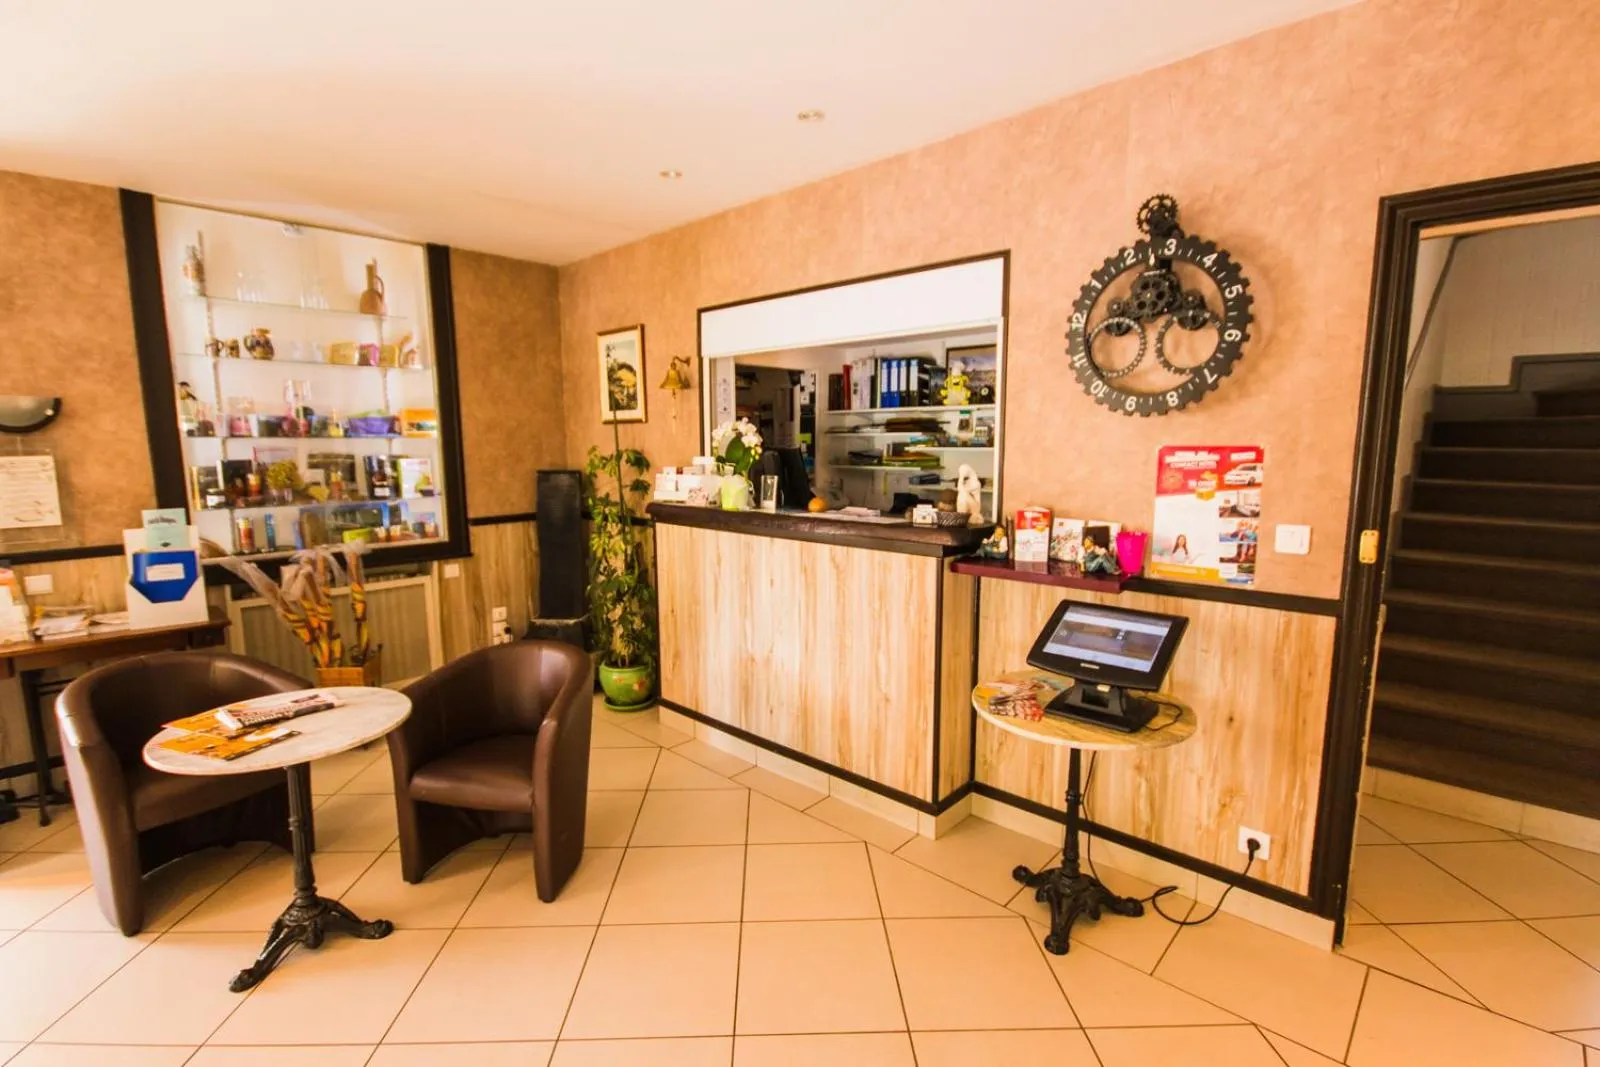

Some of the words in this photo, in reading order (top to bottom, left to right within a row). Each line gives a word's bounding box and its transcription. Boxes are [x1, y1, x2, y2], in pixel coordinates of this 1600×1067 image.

[1165, 239, 1177, 256] 3
[1123, 249, 1137, 264] 2
[1202, 253, 1218, 268] 4
[1090, 279, 1103, 290] 1
[1224, 284, 1243, 298] 5
[1072, 312, 1087, 330] 12
[1224, 329, 1242, 342] 6
[1071, 354, 1089, 368] 11
[1202, 368, 1218, 385] 7
[1090, 381, 1105, 398] 10
[1125, 395, 1138, 412] 9
[1166, 391, 1179, 407] 8
